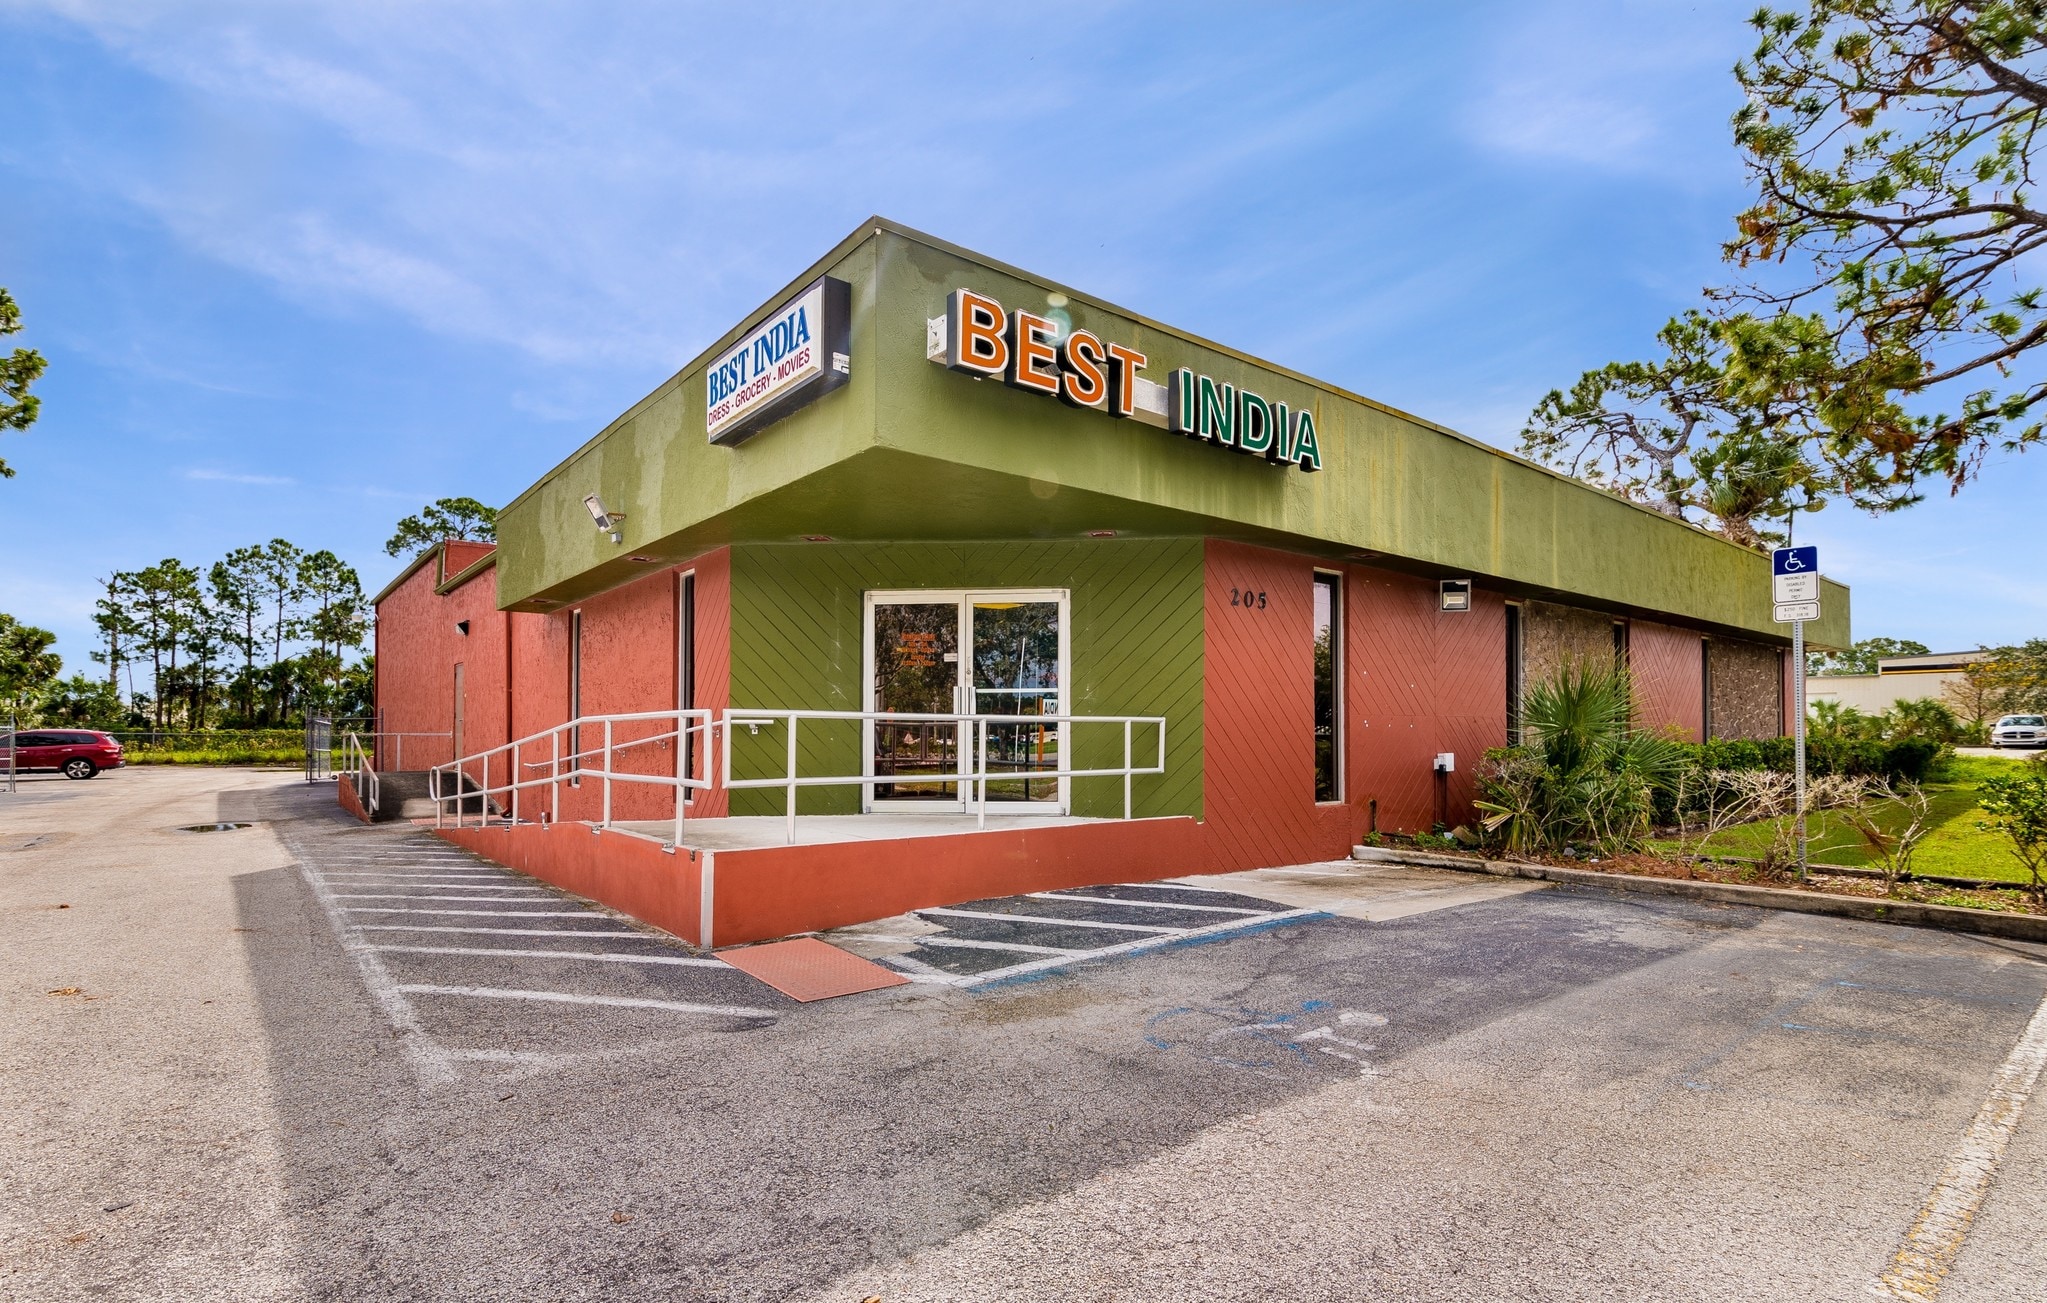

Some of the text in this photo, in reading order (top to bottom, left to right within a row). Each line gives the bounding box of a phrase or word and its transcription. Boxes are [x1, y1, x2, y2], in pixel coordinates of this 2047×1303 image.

[708, 401, 731, 426] DRESS
[735, 372, 772, 408] GROCERY
[777, 347, 811, 383] MOVIES
[709, 304, 811, 408] BEST INDIA
[955, 287, 1322, 472] BEST INDIA
[1230, 587, 1267, 610] 205
